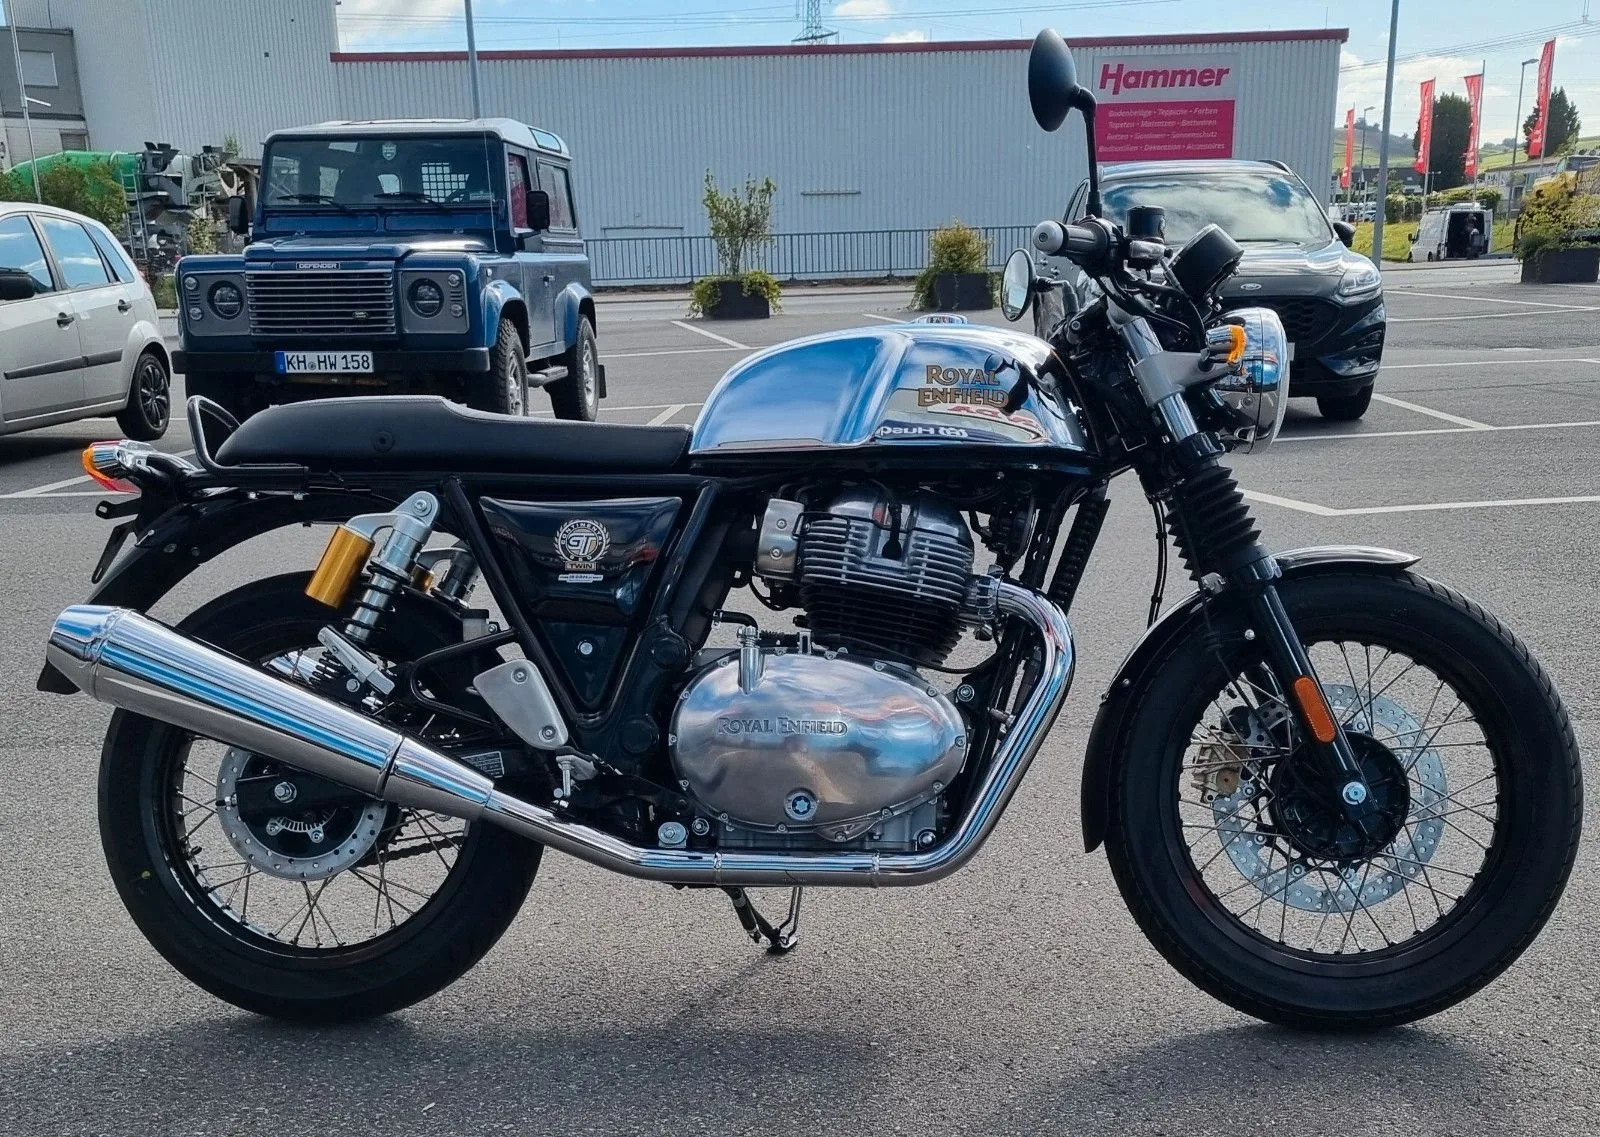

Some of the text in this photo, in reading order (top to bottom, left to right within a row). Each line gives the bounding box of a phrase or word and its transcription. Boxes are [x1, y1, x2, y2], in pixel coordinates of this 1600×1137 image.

[1099, 63, 1230, 95] Hammer
[1193, 106, 1218, 115] Farben
[286, 354, 307, 371] KH
[317, 354, 337, 371] HW
[341, 354, 371, 370] 158
[926, 365, 1000, 386] ROYAL
[918, 387, 1009, 408] ENFIELD
[561, 522, 603, 545] CONTINENTAL
[568, 532, 597, 556] GT
[717, 716, 848, 736] ROYAL ENFIELD
